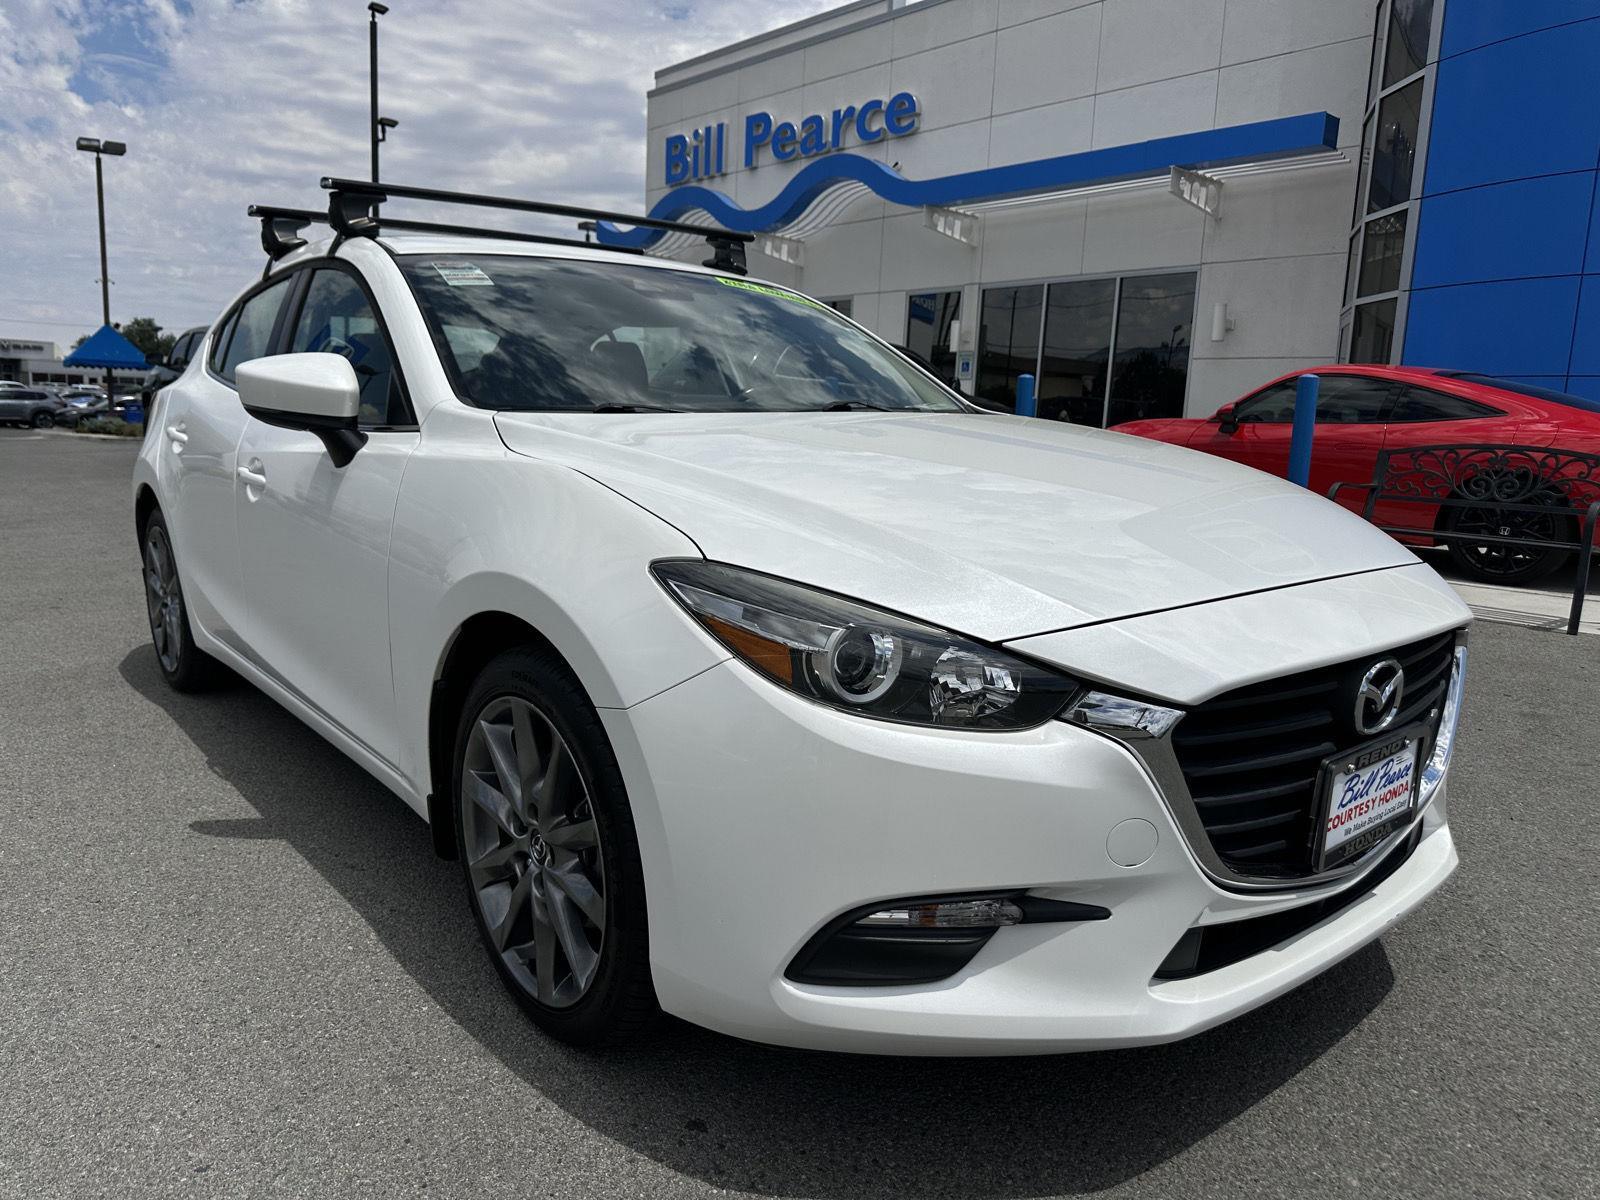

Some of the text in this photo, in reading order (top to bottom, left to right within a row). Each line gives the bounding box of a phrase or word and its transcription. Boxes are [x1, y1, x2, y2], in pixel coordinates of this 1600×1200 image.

[666, 92, 917, 185] Bill Pearce
[1357, 740, 1402, 769] RENO
[1338, 758, 1412, 809] Bill Pearce
[1378, 780, 1409, 807] HONDA
[1343, 823, 1393, 857] HONDA
